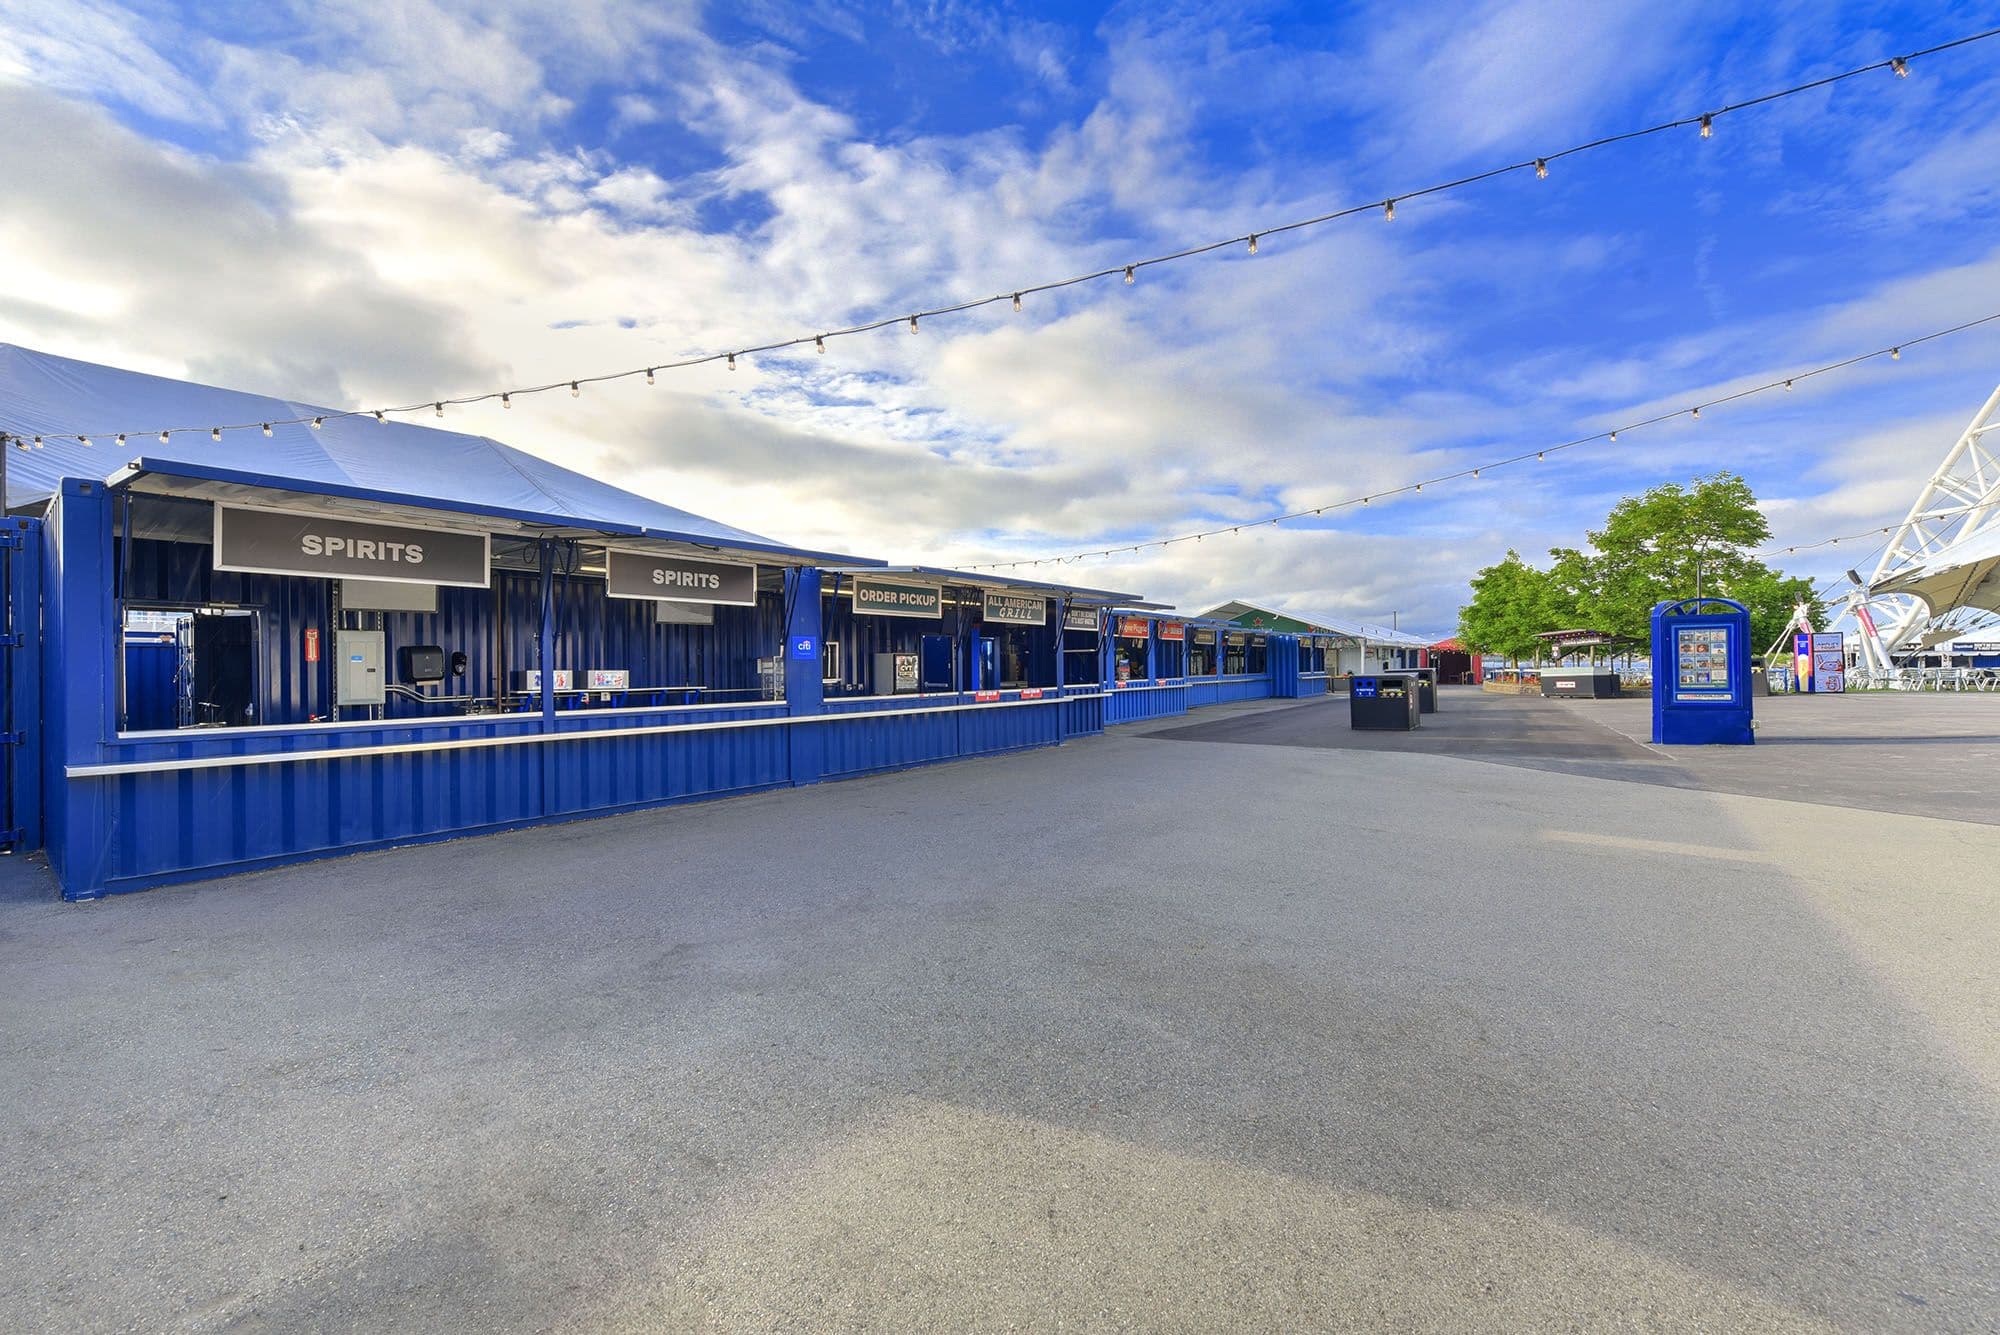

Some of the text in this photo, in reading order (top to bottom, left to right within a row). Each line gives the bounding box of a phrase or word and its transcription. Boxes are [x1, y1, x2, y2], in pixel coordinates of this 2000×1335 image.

[301, 534, 424, 564] SPIRITS
[652, 568, 720, 589] SPIRITS
[860, 588, 936, 606] ORDER PICKUP
[988, 596, 1042, 611] ALL AMERICAN
[999, 607, 1032, 619] GRILL
[797, 641, 811, 651] citi
